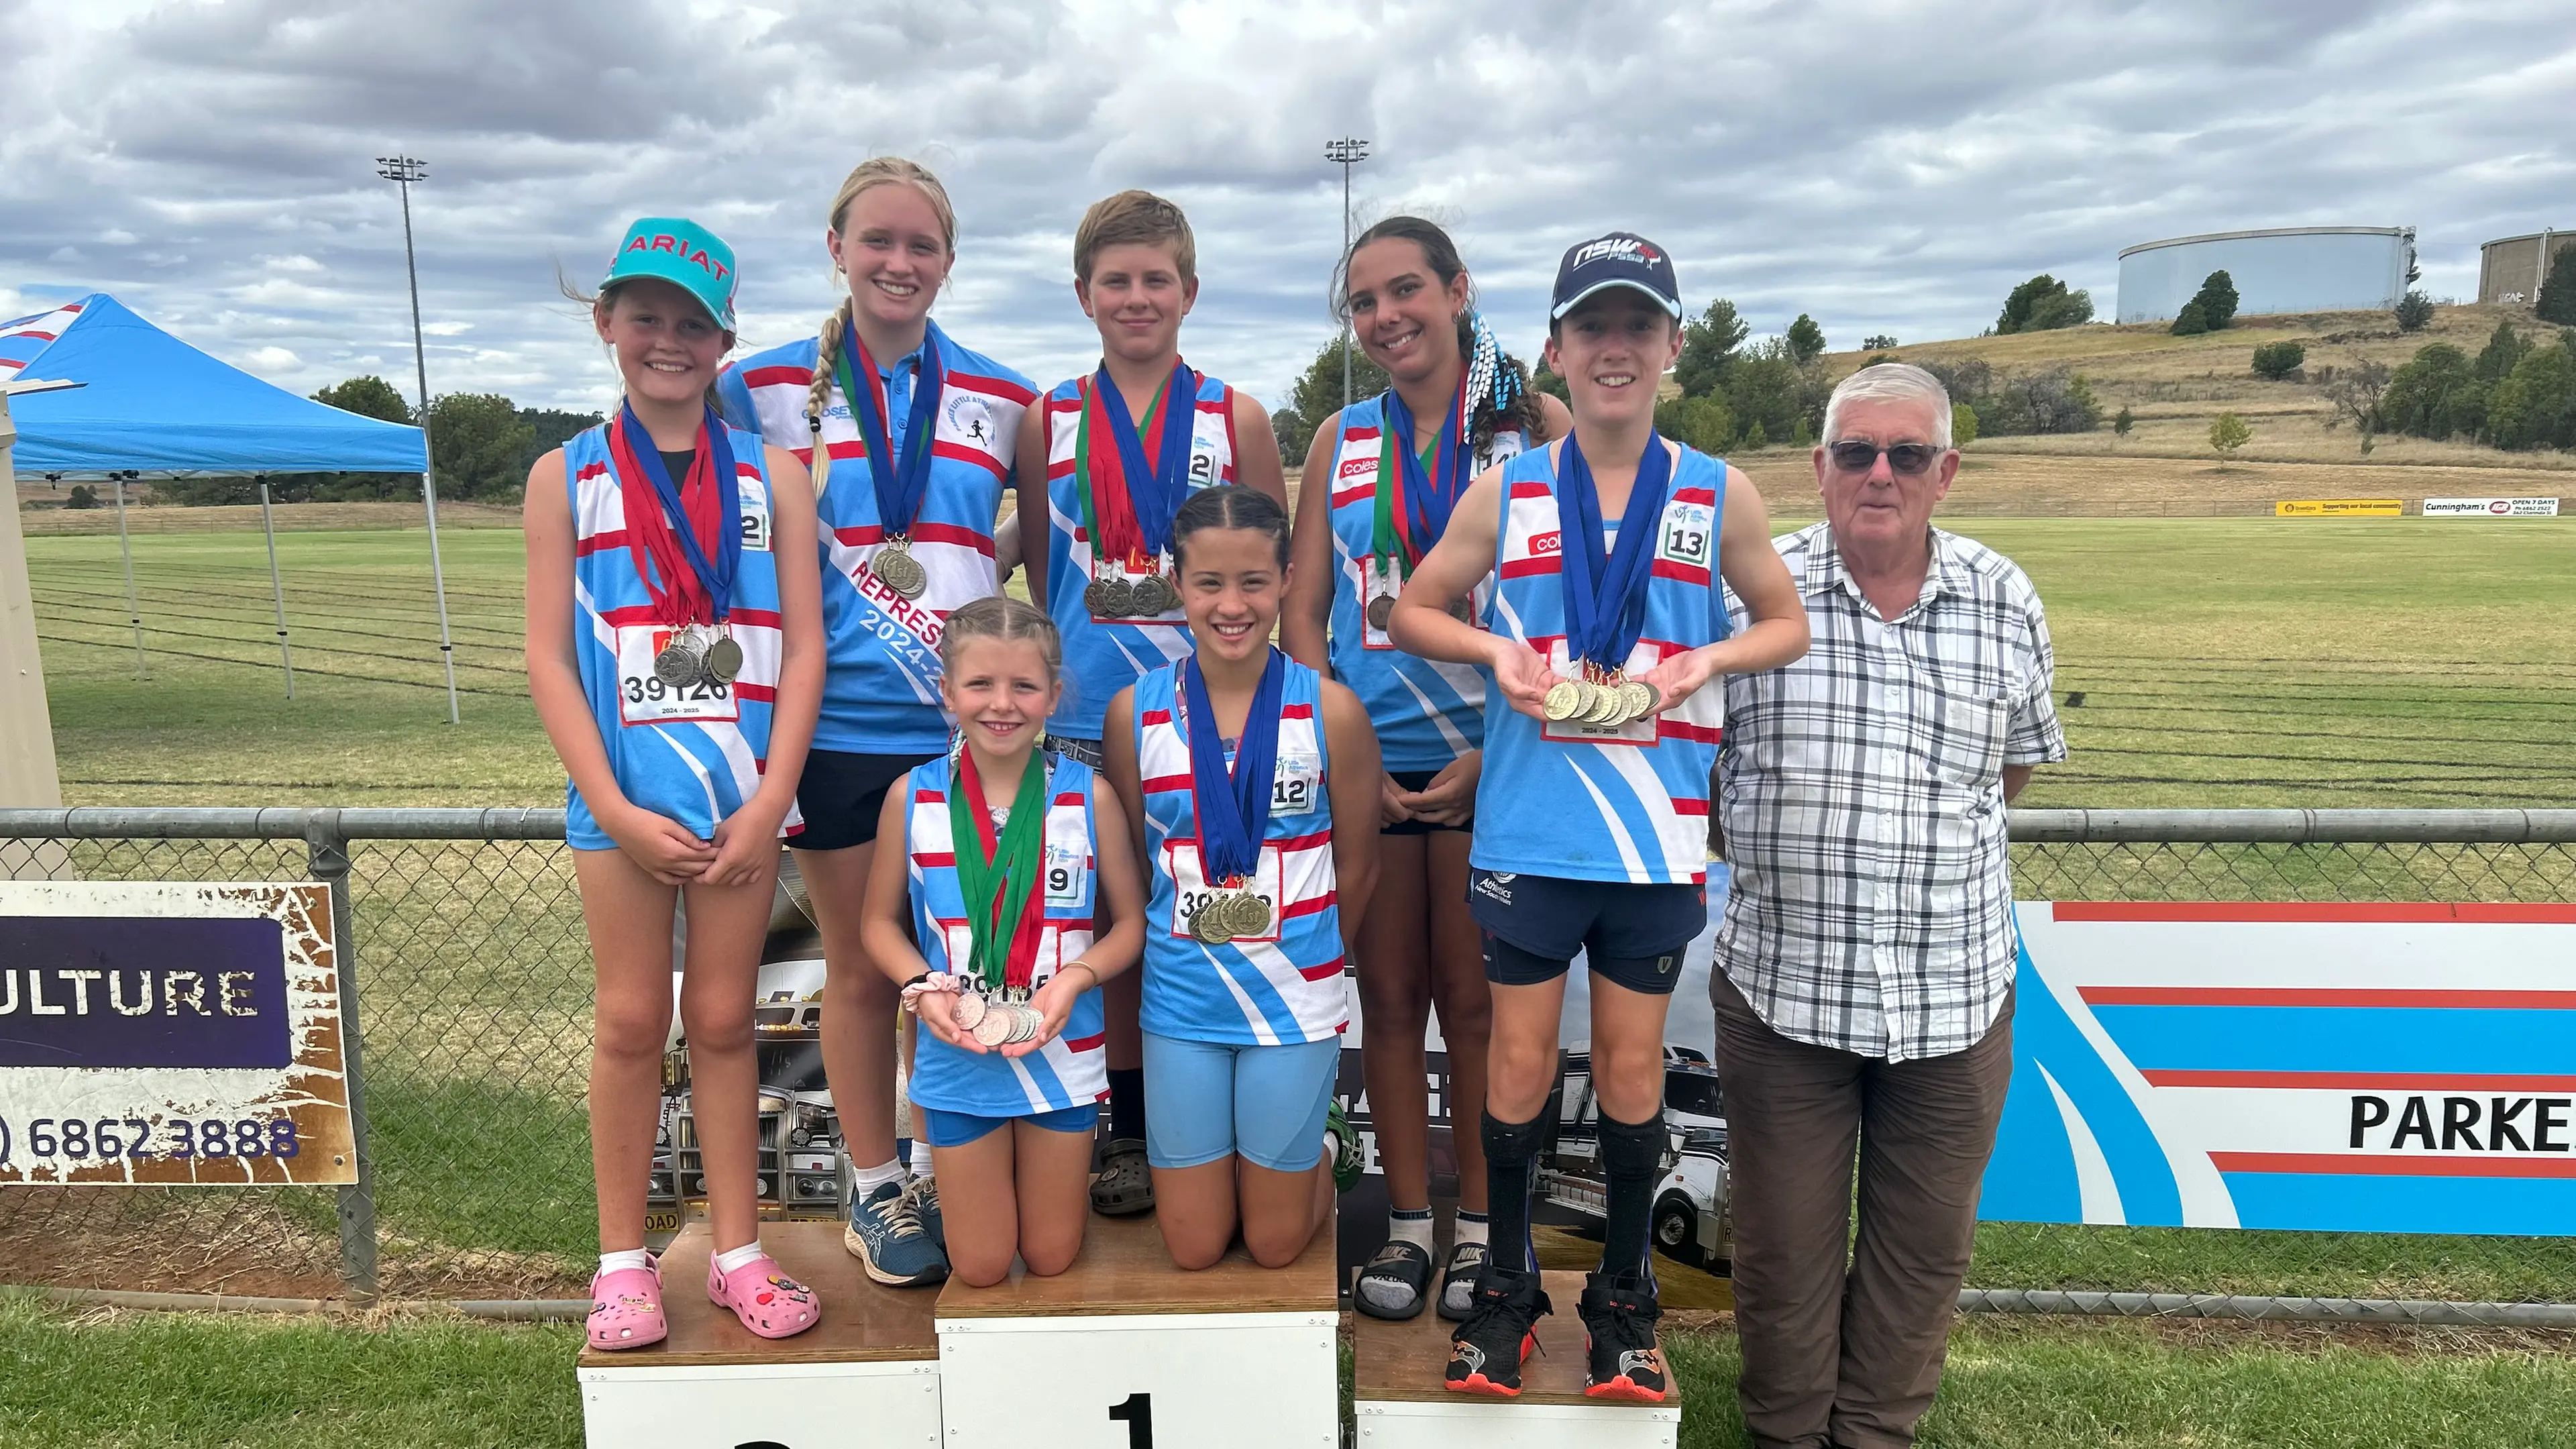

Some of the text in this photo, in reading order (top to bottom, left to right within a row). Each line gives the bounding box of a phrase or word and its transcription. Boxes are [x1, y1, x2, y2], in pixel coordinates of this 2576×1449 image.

[627, 235, 729, 282] ARIAT
[951, 395, 971, 410] LITTLE
[1344, 460, 1379, 475] coles
[2425, 502, 2485, 512] Cunningham's
[1670, 529, 1703, 556] 13
[851, 561, 943, 656] REPRES
[859, 609, 944, 698] 2024-2
[1275, 780, 1305, 803] 12
[1049, 868, 1068, 891] 9
[1479, 878, 1512, 898] Athletics
[2350, 1096, 2576, 1152] PARKE
[31, 1118, 151, 1158] 6862
[168, 1119, 300, 1159] 3888
[1377, 1246, 1411, 1258] NIKE
